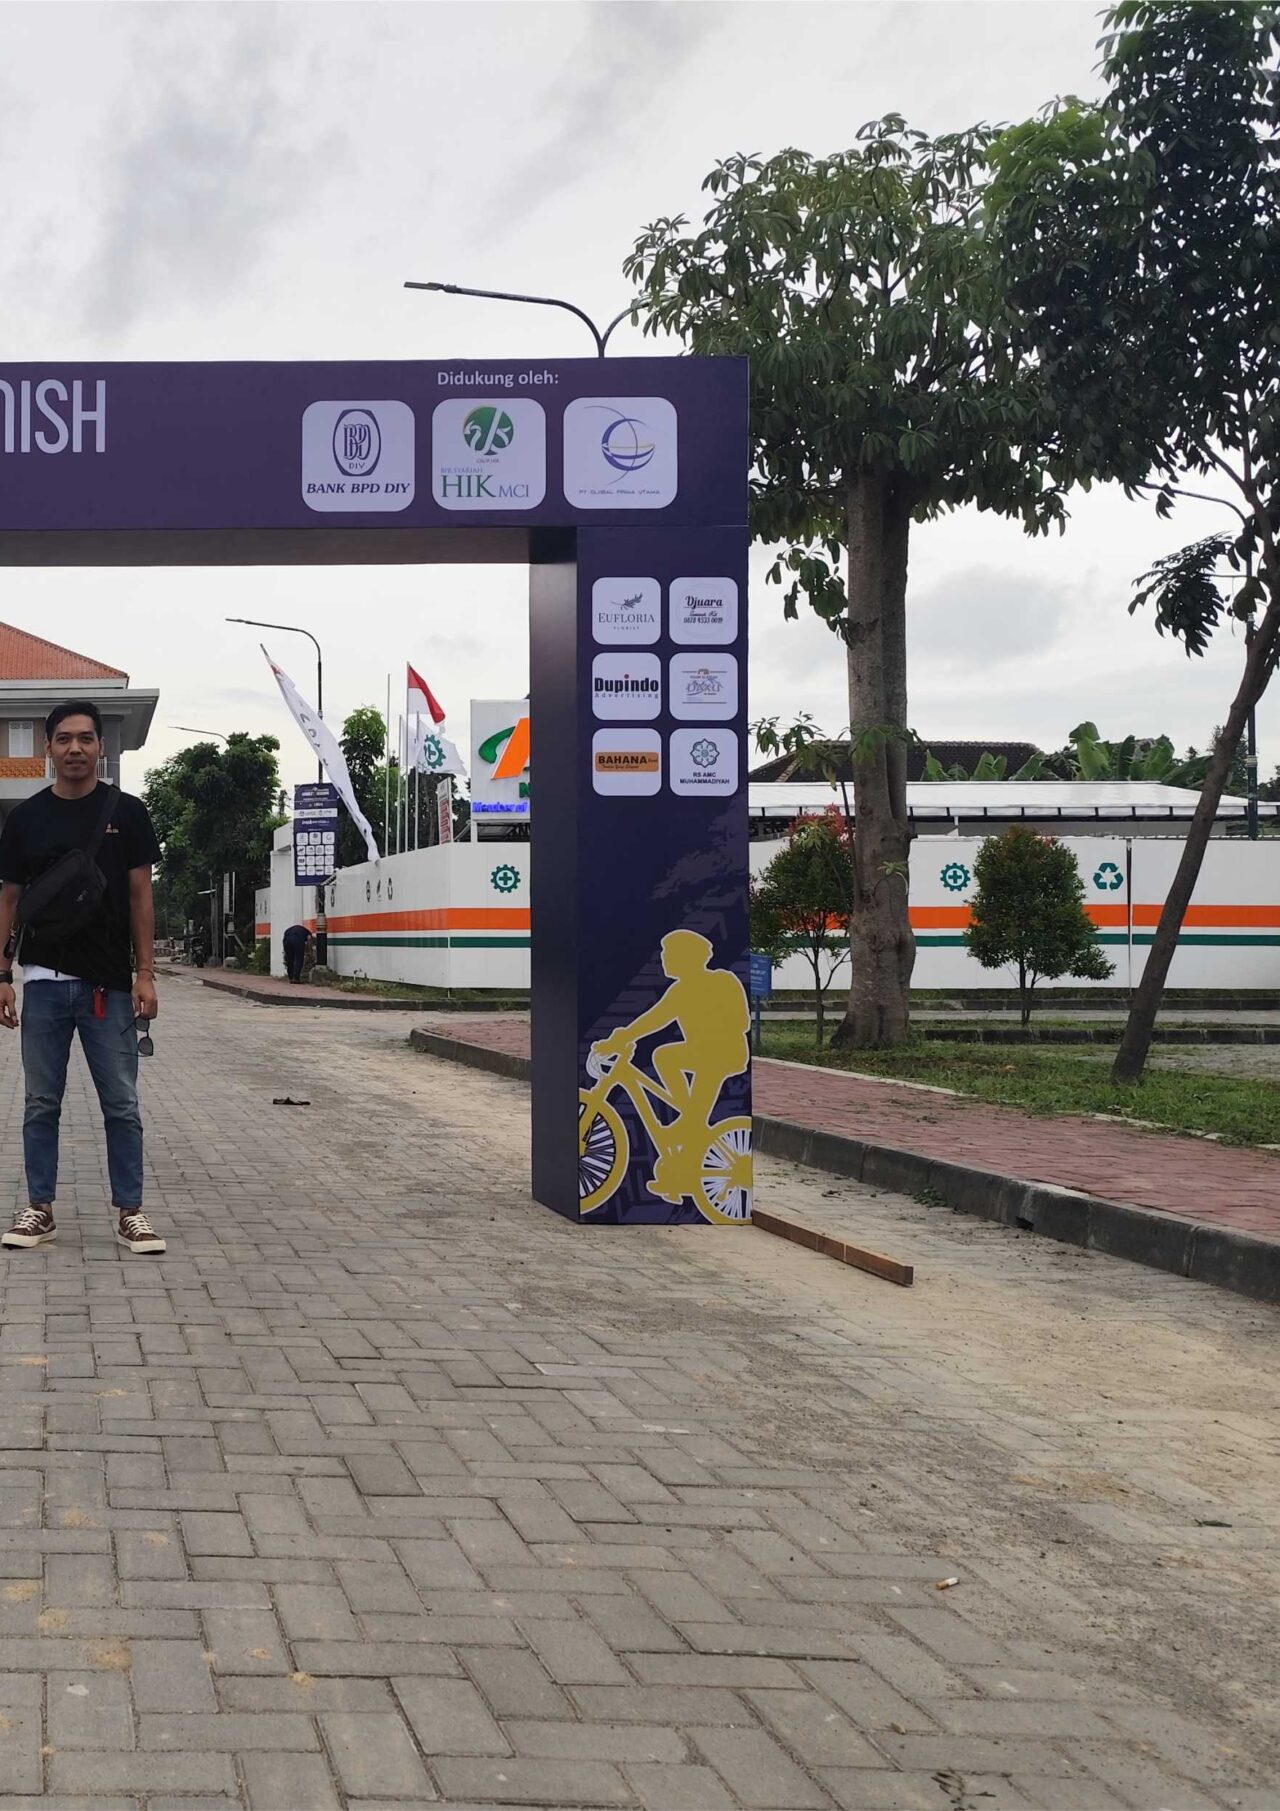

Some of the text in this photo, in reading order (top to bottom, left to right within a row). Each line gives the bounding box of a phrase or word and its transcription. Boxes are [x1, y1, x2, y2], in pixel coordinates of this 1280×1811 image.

[437, 370, 559, 388] Didukung oleh:
[306, 483, 411, 494] BANK BPD DIY
[440, 474, 529, 498] HIK MCI
[594, 673, 659, 693] Dupindo
[598, 755, 648, 765] BAHANA
